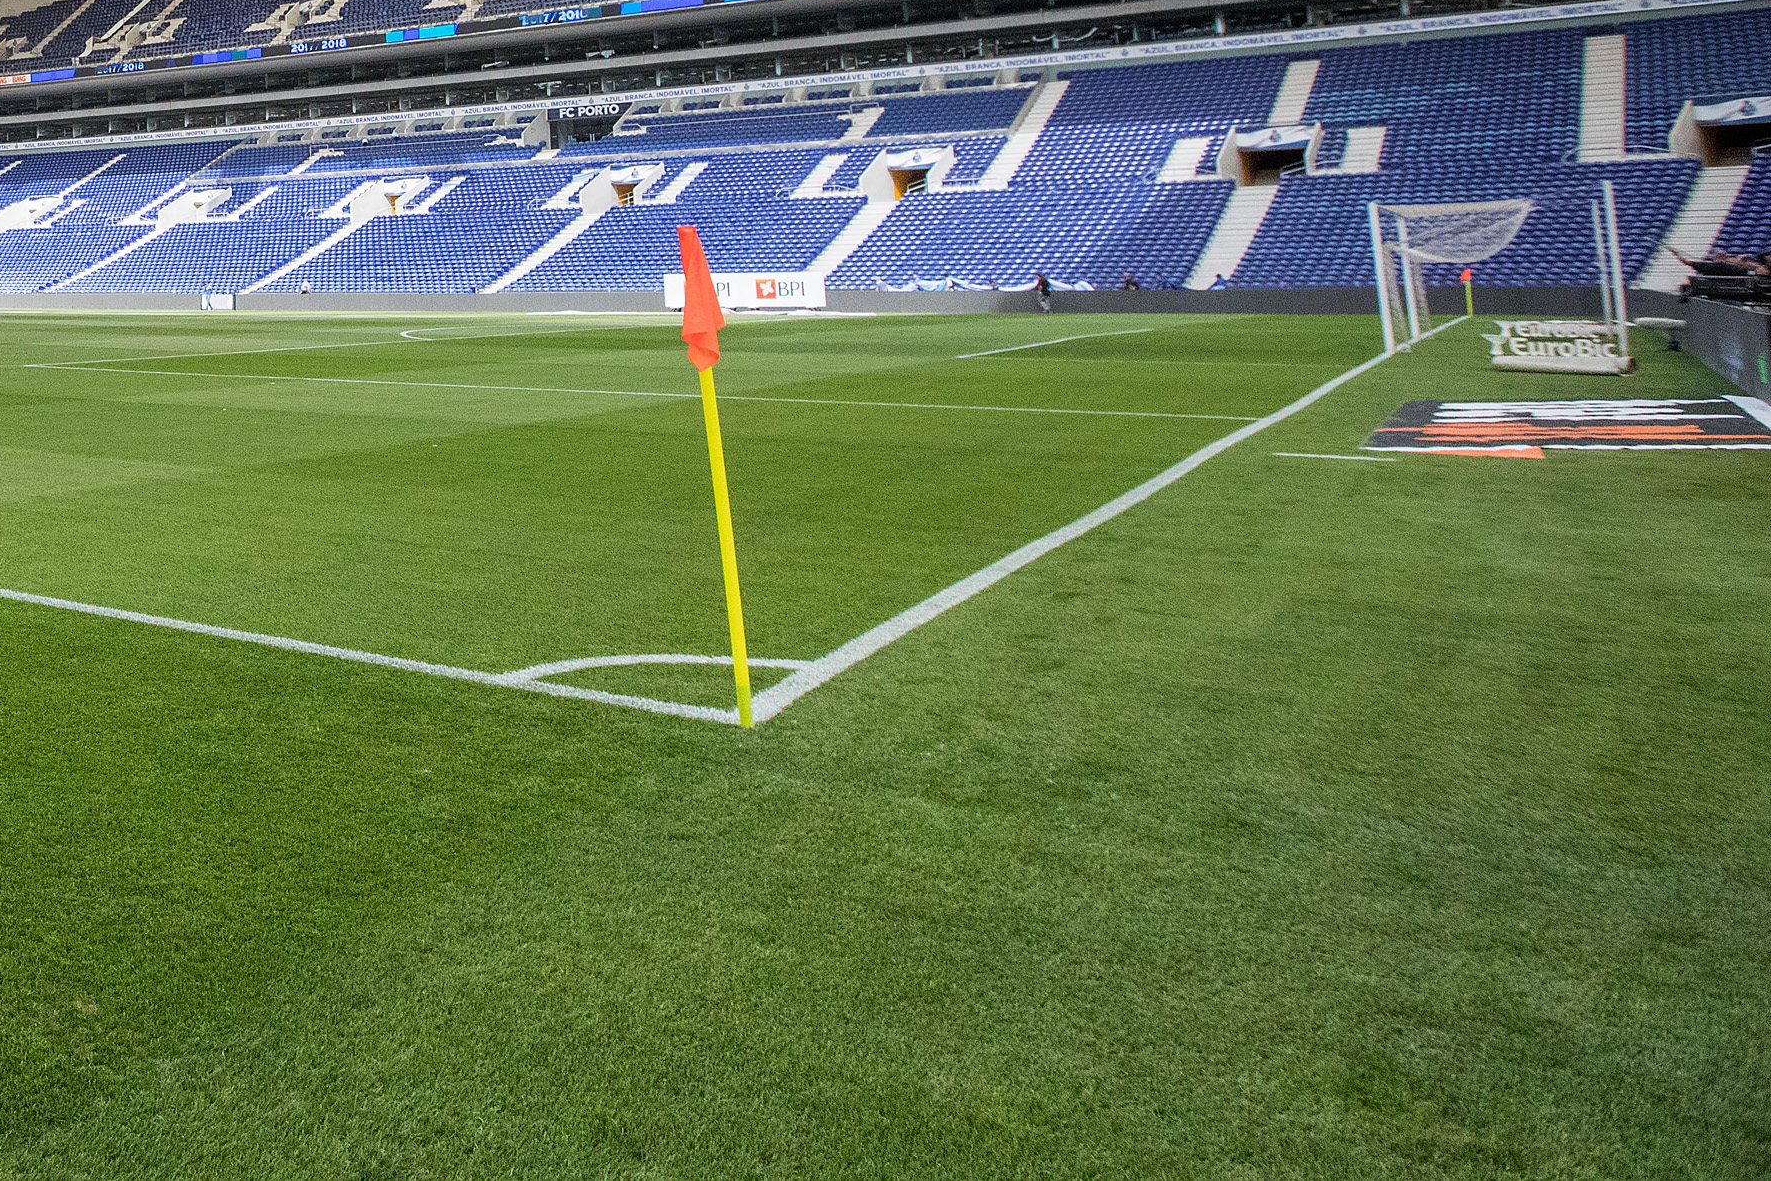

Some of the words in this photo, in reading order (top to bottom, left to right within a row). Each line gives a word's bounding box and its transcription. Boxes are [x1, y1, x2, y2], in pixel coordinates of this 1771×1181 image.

[785, 79, 818, 87] BRANCA,
[625, 92, 654, 101] BRANCA,
[559, 107, 575, 118] FC
[578, 104, 619, 117] PORTO
[778, 282, 804, 296] BPI
[1509, 337, 1618, 358] EuroBic
